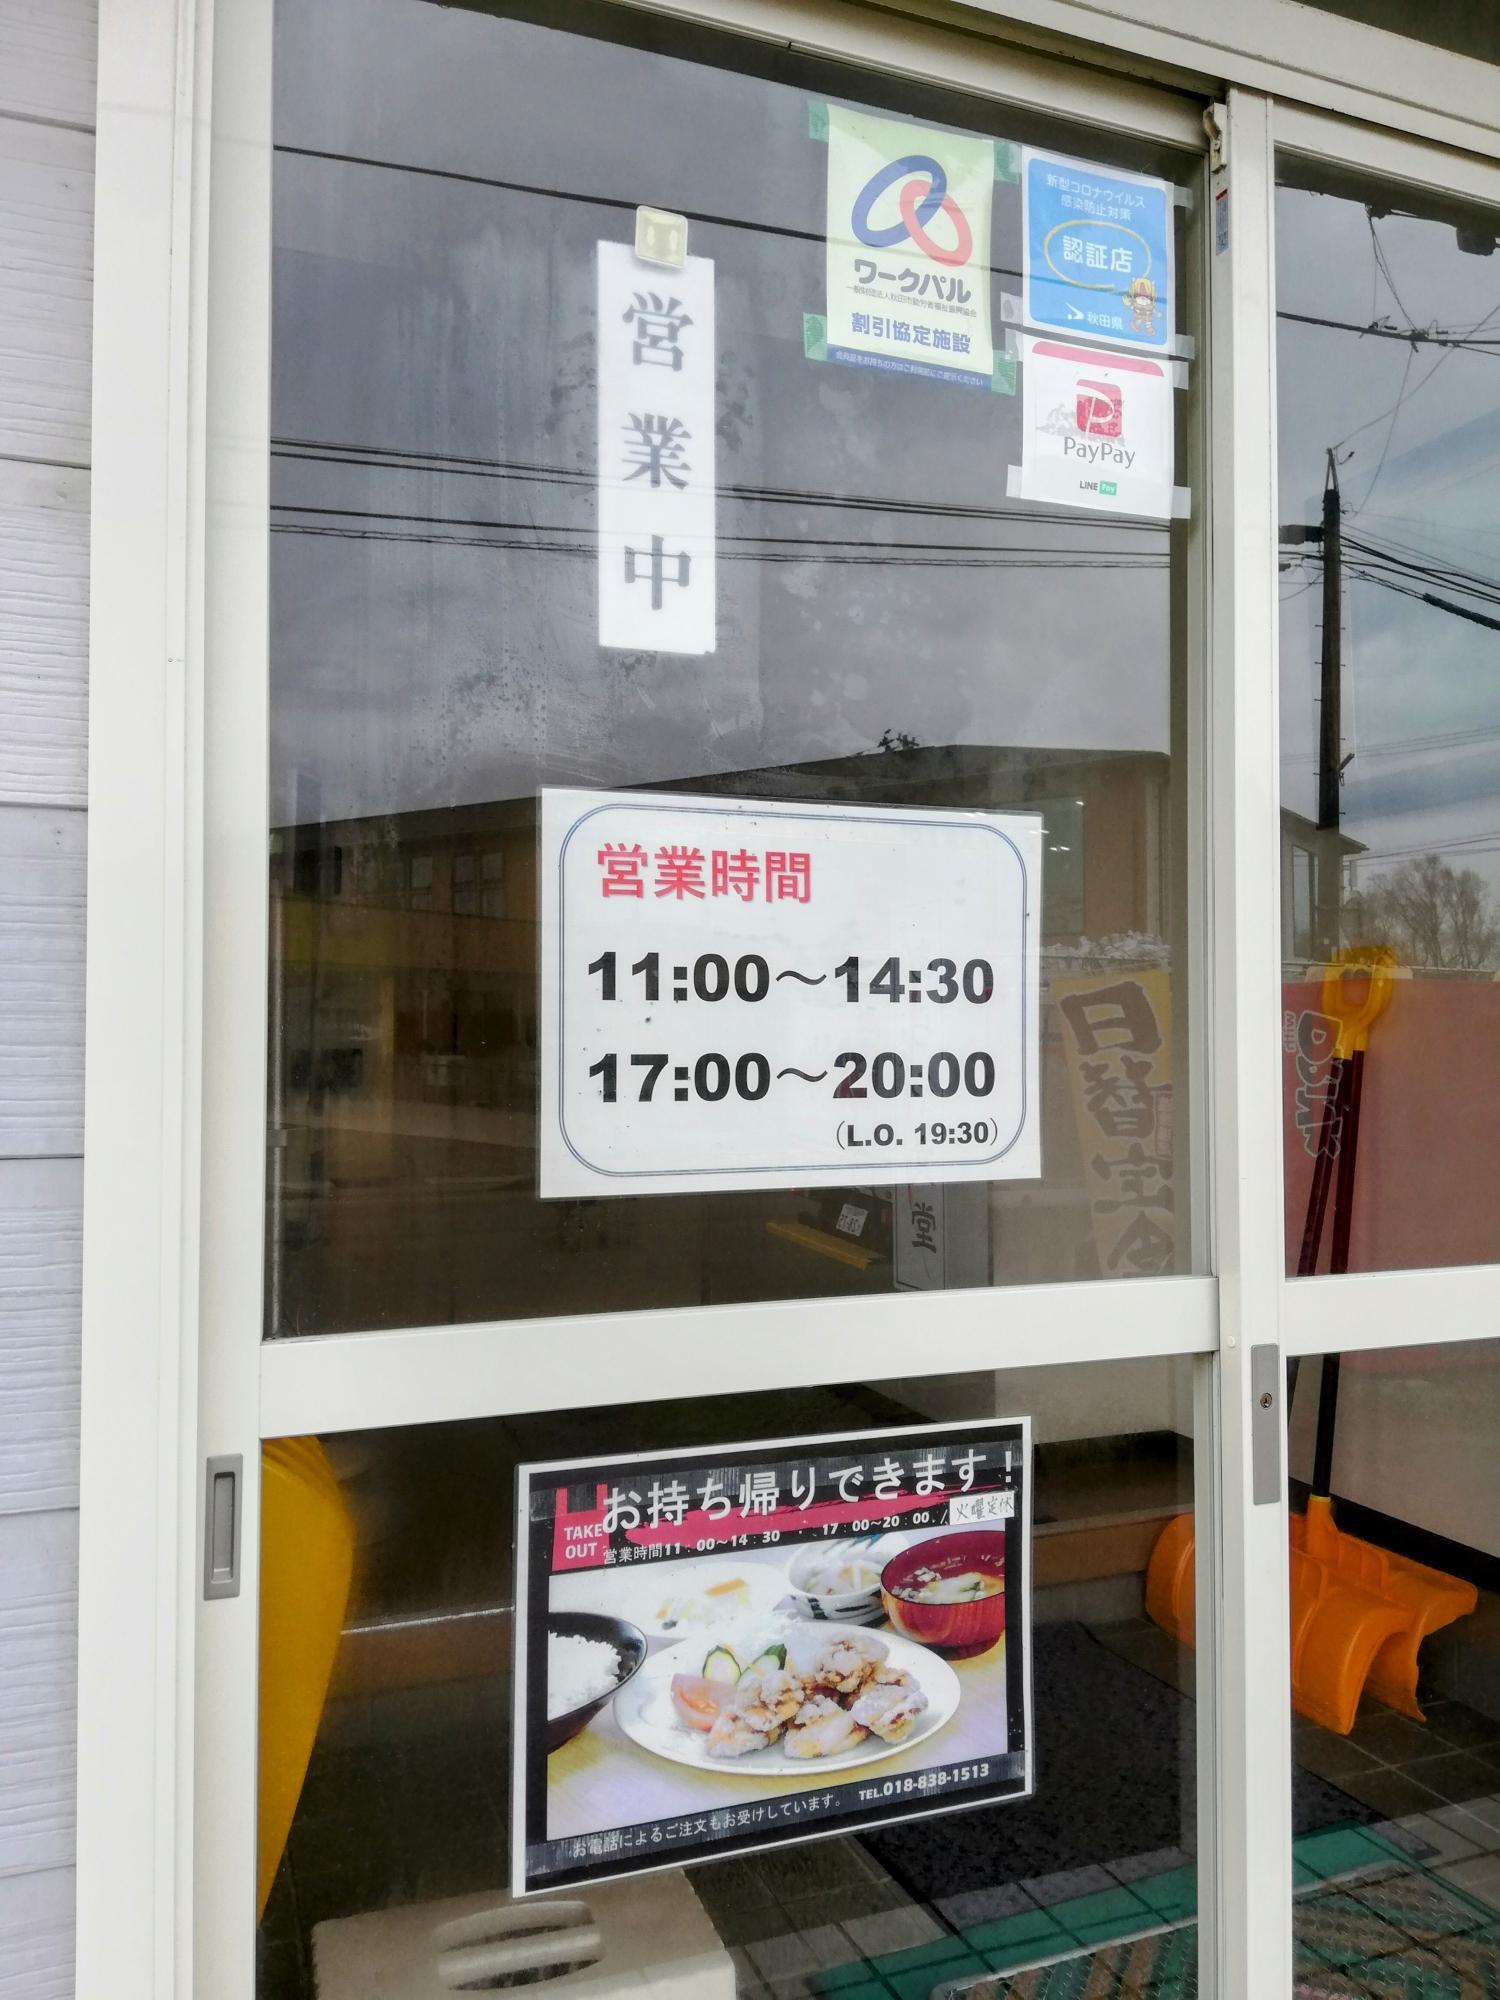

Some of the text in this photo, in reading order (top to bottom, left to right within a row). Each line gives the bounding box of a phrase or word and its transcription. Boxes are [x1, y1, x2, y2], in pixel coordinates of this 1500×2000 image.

[1046, 174, 1146, 208] 新型コロナウイルス
[1063, 236, 1133, 273] 認証店
[854, 259, 972, 304] ワークパル
[851, 312, 971, 355] 割引協定施設
[1087, 311, 1124, 330] 秋田県
[622, 291, 694, 611] 営業中
[1064, 436, 1136, 469] PayPay
[1079, 480, 1098, 492] LINE
[597, 842, 812, 903] 営業時間
[564, 1523, 603, 1541] TAKE
[565, 1542, 598, 1560] OUT
